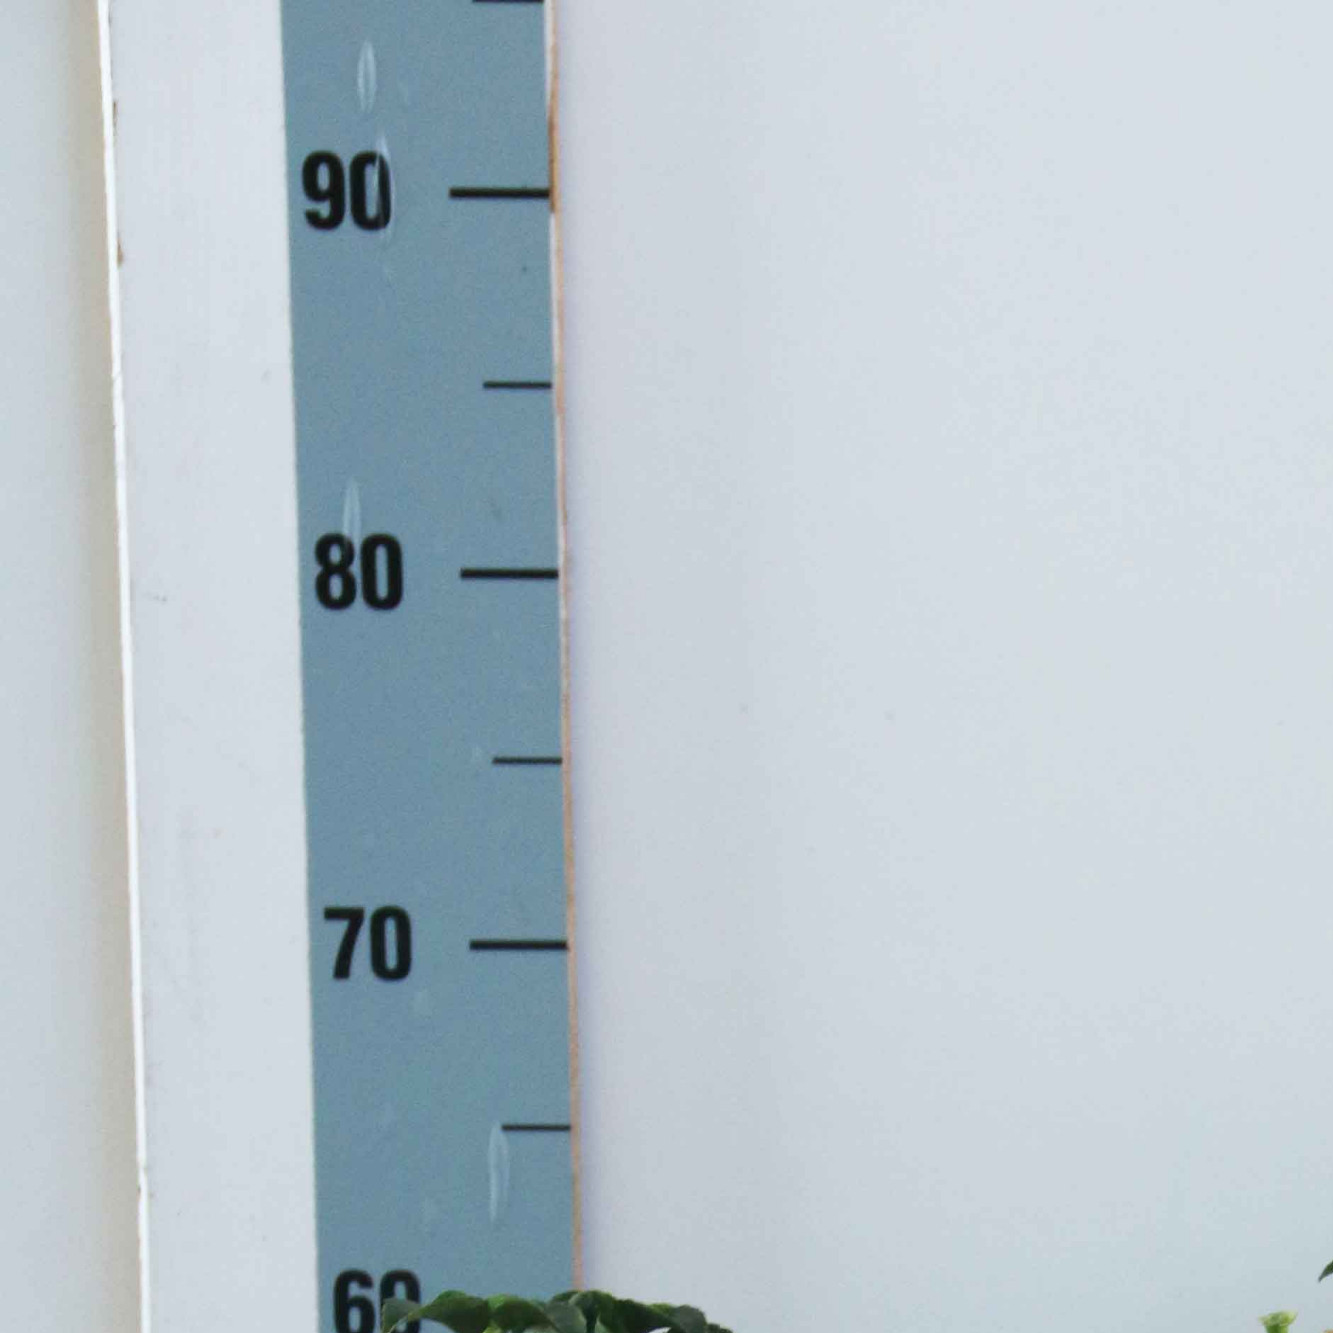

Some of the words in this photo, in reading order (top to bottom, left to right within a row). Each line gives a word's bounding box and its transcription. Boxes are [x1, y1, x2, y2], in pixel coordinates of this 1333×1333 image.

[302, 151, 393, 230] 90
[314, 533, 403, 610] 80
[323, 906, 413, 981] 70
